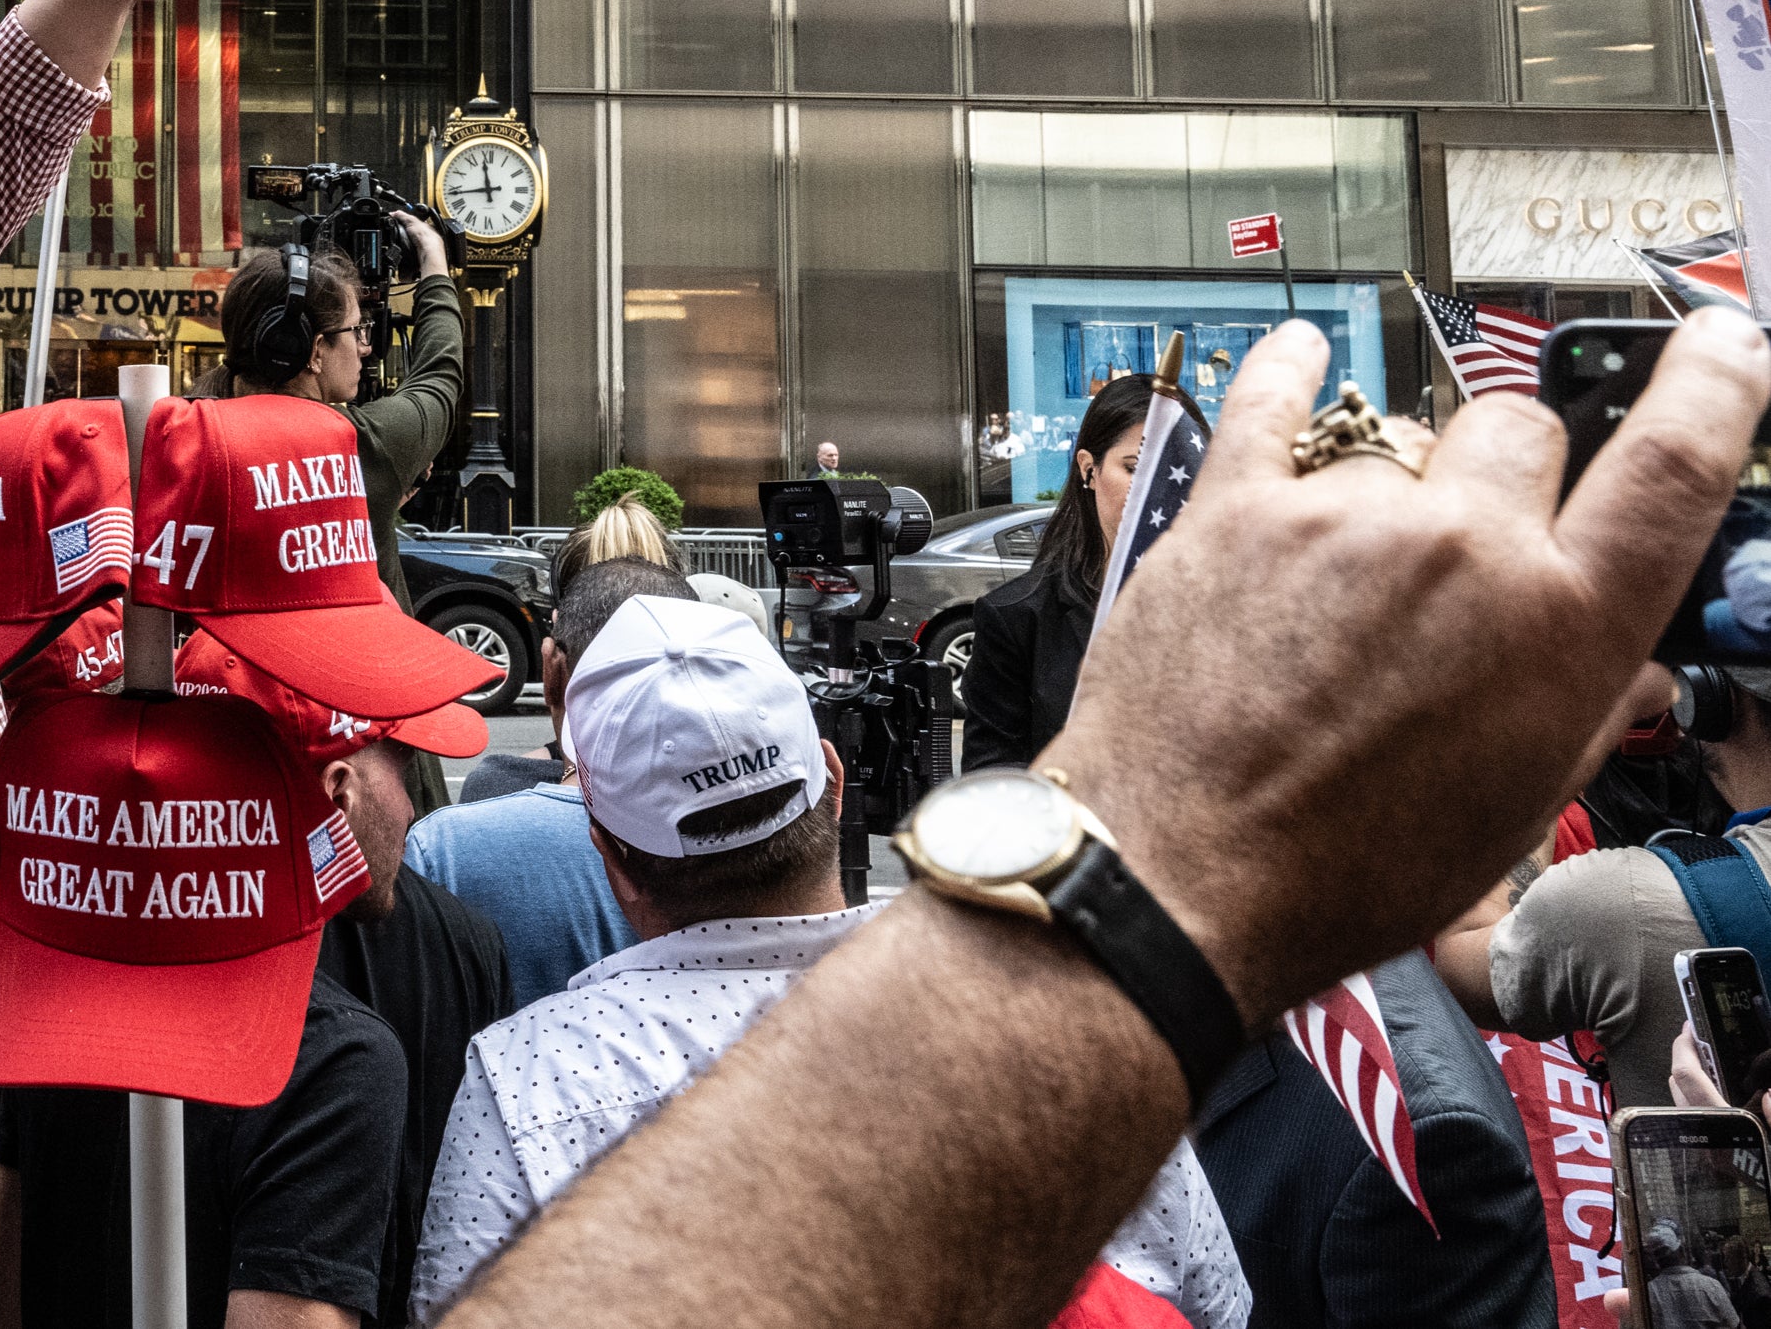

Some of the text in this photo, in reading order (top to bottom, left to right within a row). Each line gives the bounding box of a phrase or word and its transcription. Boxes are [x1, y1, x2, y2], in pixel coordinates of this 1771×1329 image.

[453, 124, 522, 141] TRUMP TOWER
[1241, 218, 1270, 231] STANDING
[90, 288, 220, 317] TOWER
[247, 453, 347, 511] MAKE
[843, 500, 868, 509] NANLITE
[278, 518, 368, 573] GREAT
[681, 744, 781, 794] TRUMP
[5, 783, 281, 850] MAKE AMERICA
[20, 856, 267, 920] GREAT AGAIN
